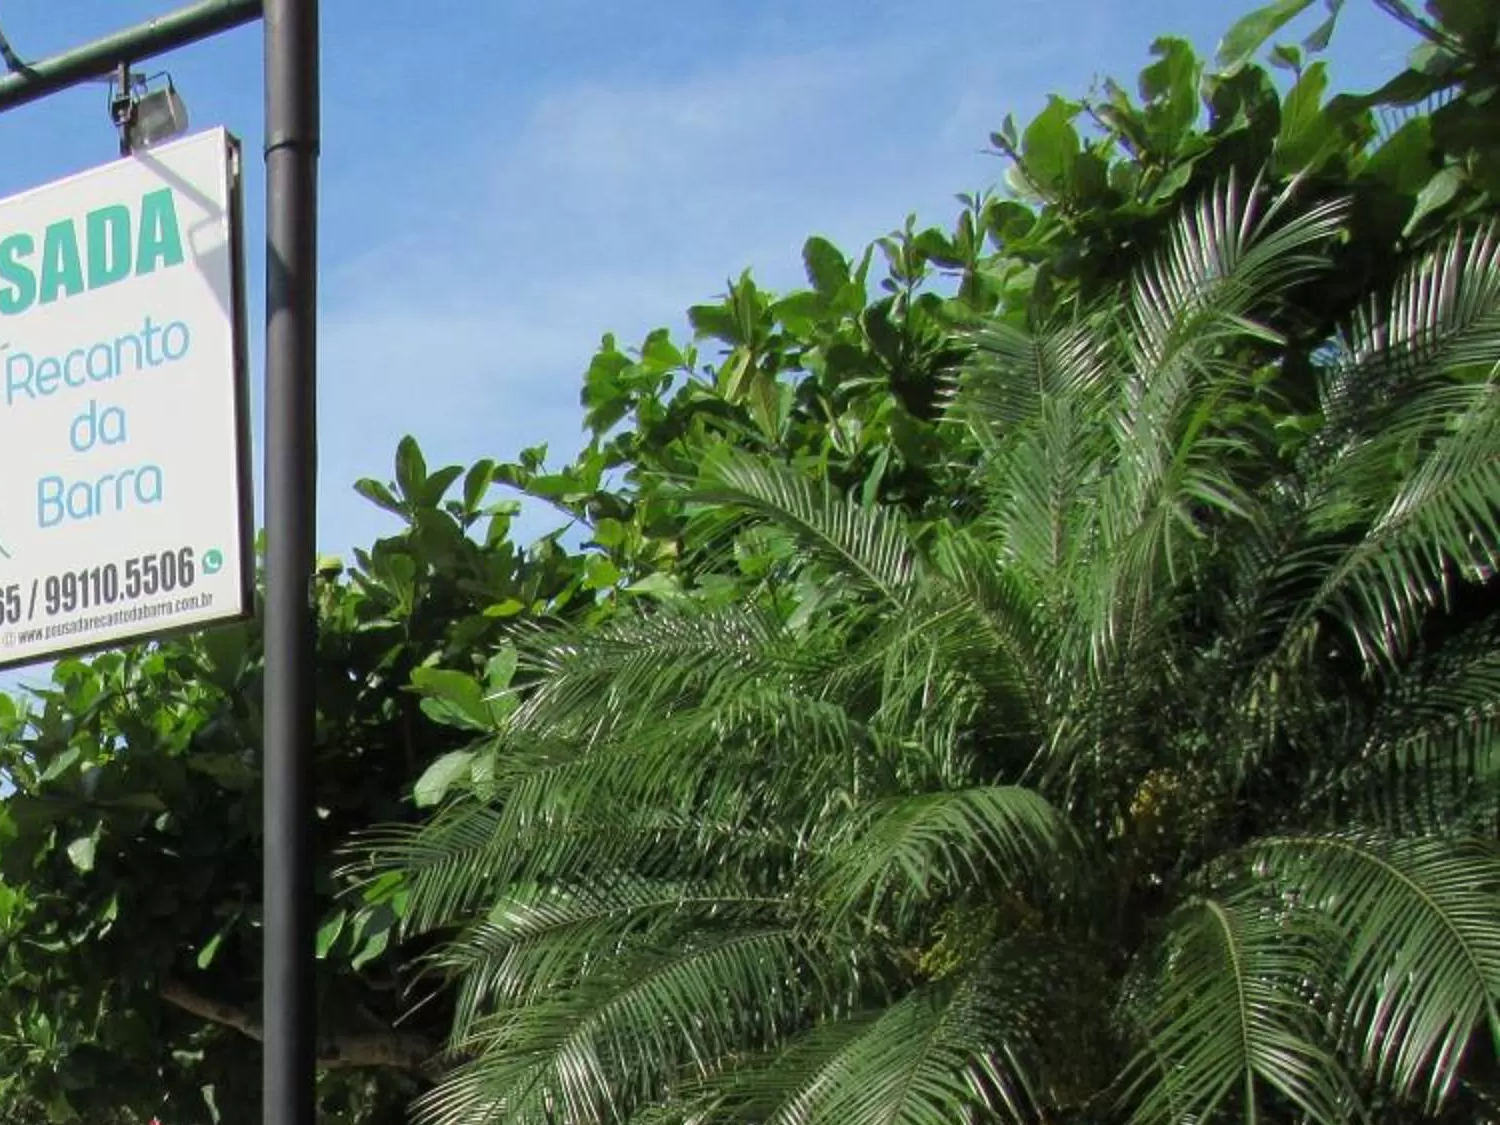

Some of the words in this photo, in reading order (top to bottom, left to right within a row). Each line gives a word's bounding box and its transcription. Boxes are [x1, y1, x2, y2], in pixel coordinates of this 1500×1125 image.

[5, 316, 190, 405] Recanto
[70, 399, 126, 452] da
[37, 465, 163, 528] Barra
[45, 545, 195, 615] 99110.5506
